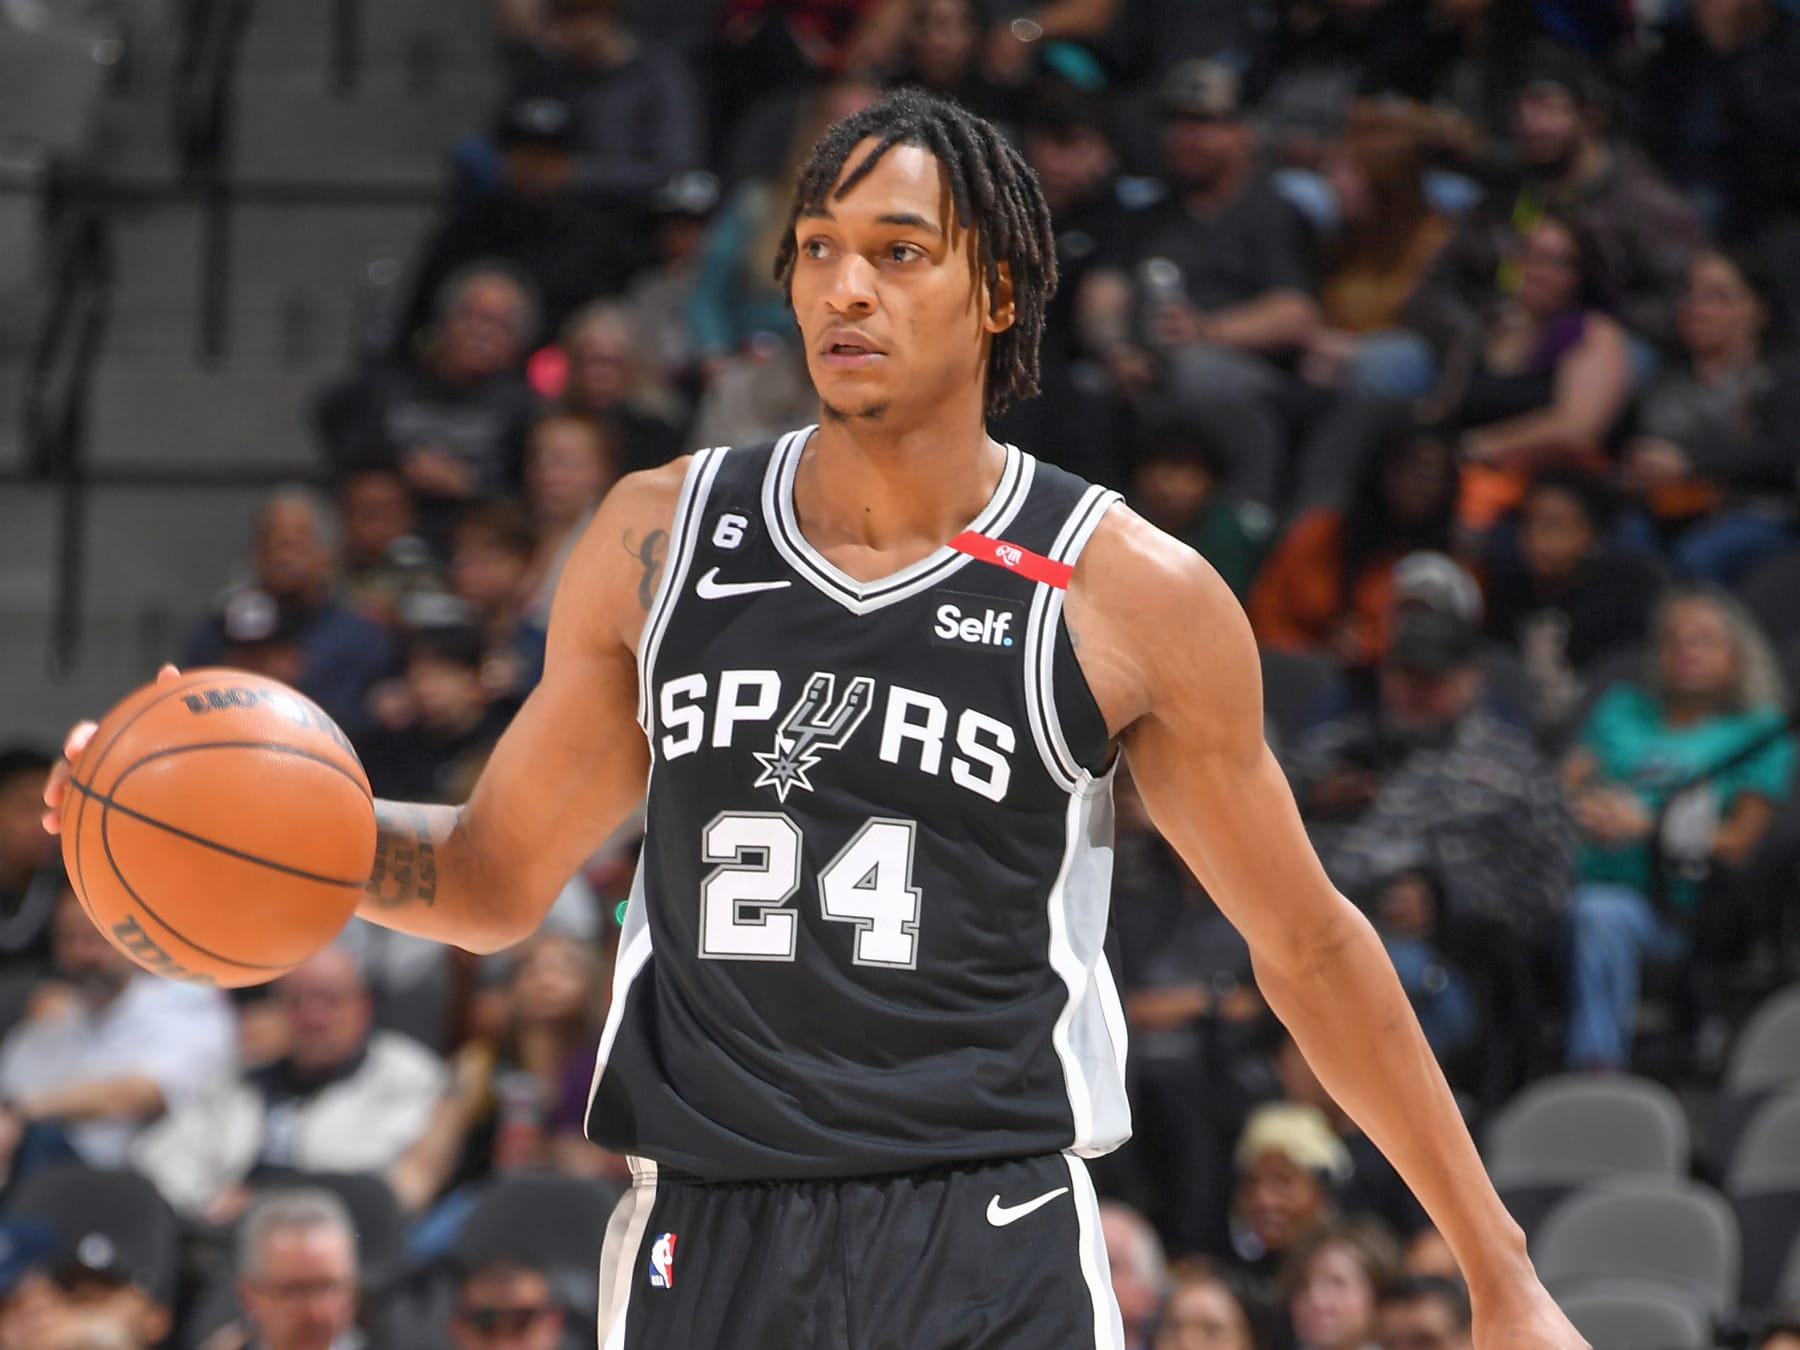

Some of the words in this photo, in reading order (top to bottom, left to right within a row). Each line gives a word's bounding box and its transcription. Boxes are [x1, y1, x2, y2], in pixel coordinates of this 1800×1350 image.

[712, 513, 748, 549] 6
[934, 604, 1013, 647] Self.
[660, 669, 1016, 803] SPURS
[698, 811, 922, 970] 24
